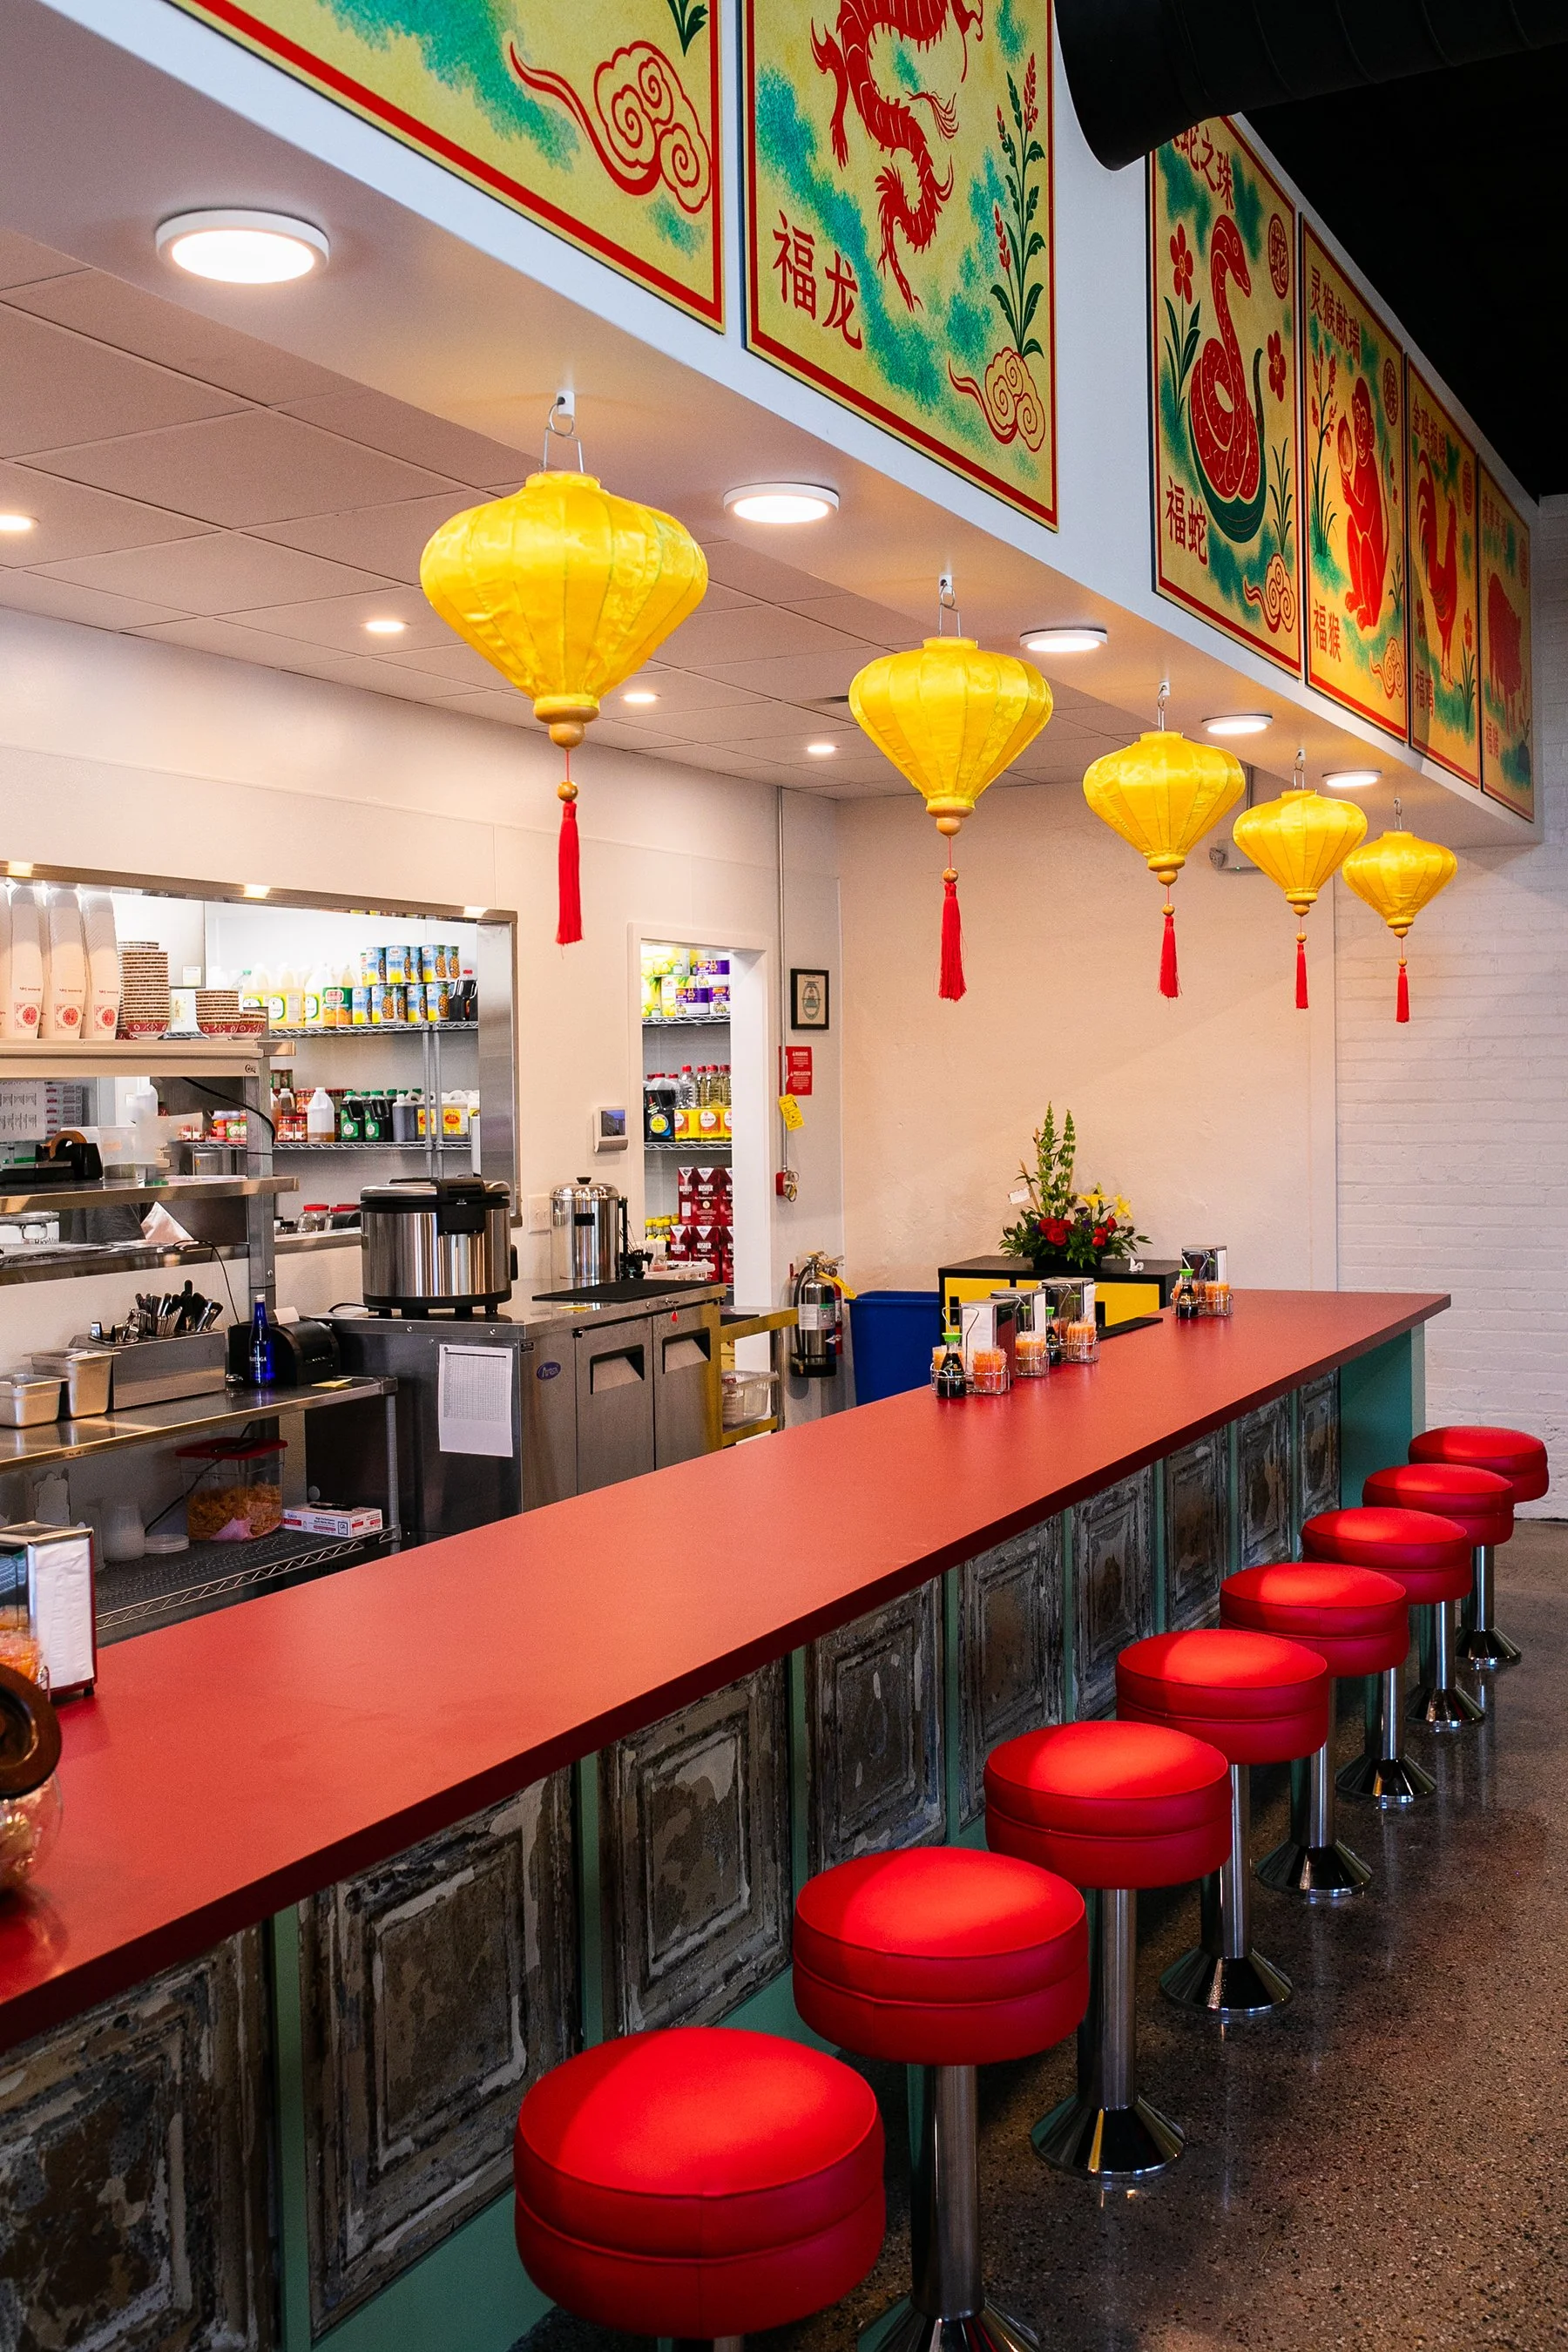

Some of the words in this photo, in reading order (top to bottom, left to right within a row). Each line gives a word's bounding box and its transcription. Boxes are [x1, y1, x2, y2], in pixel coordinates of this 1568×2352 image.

[1173, 125, 1233, 210] 蛇之珠
[773, 209, 862, 350] 福龙
[1311, 265, 1360, 366] 灵猴献瑞
[1166, 475, 1208, 565] 福蛇
[1314, 598, 1341, 662] 福猴
